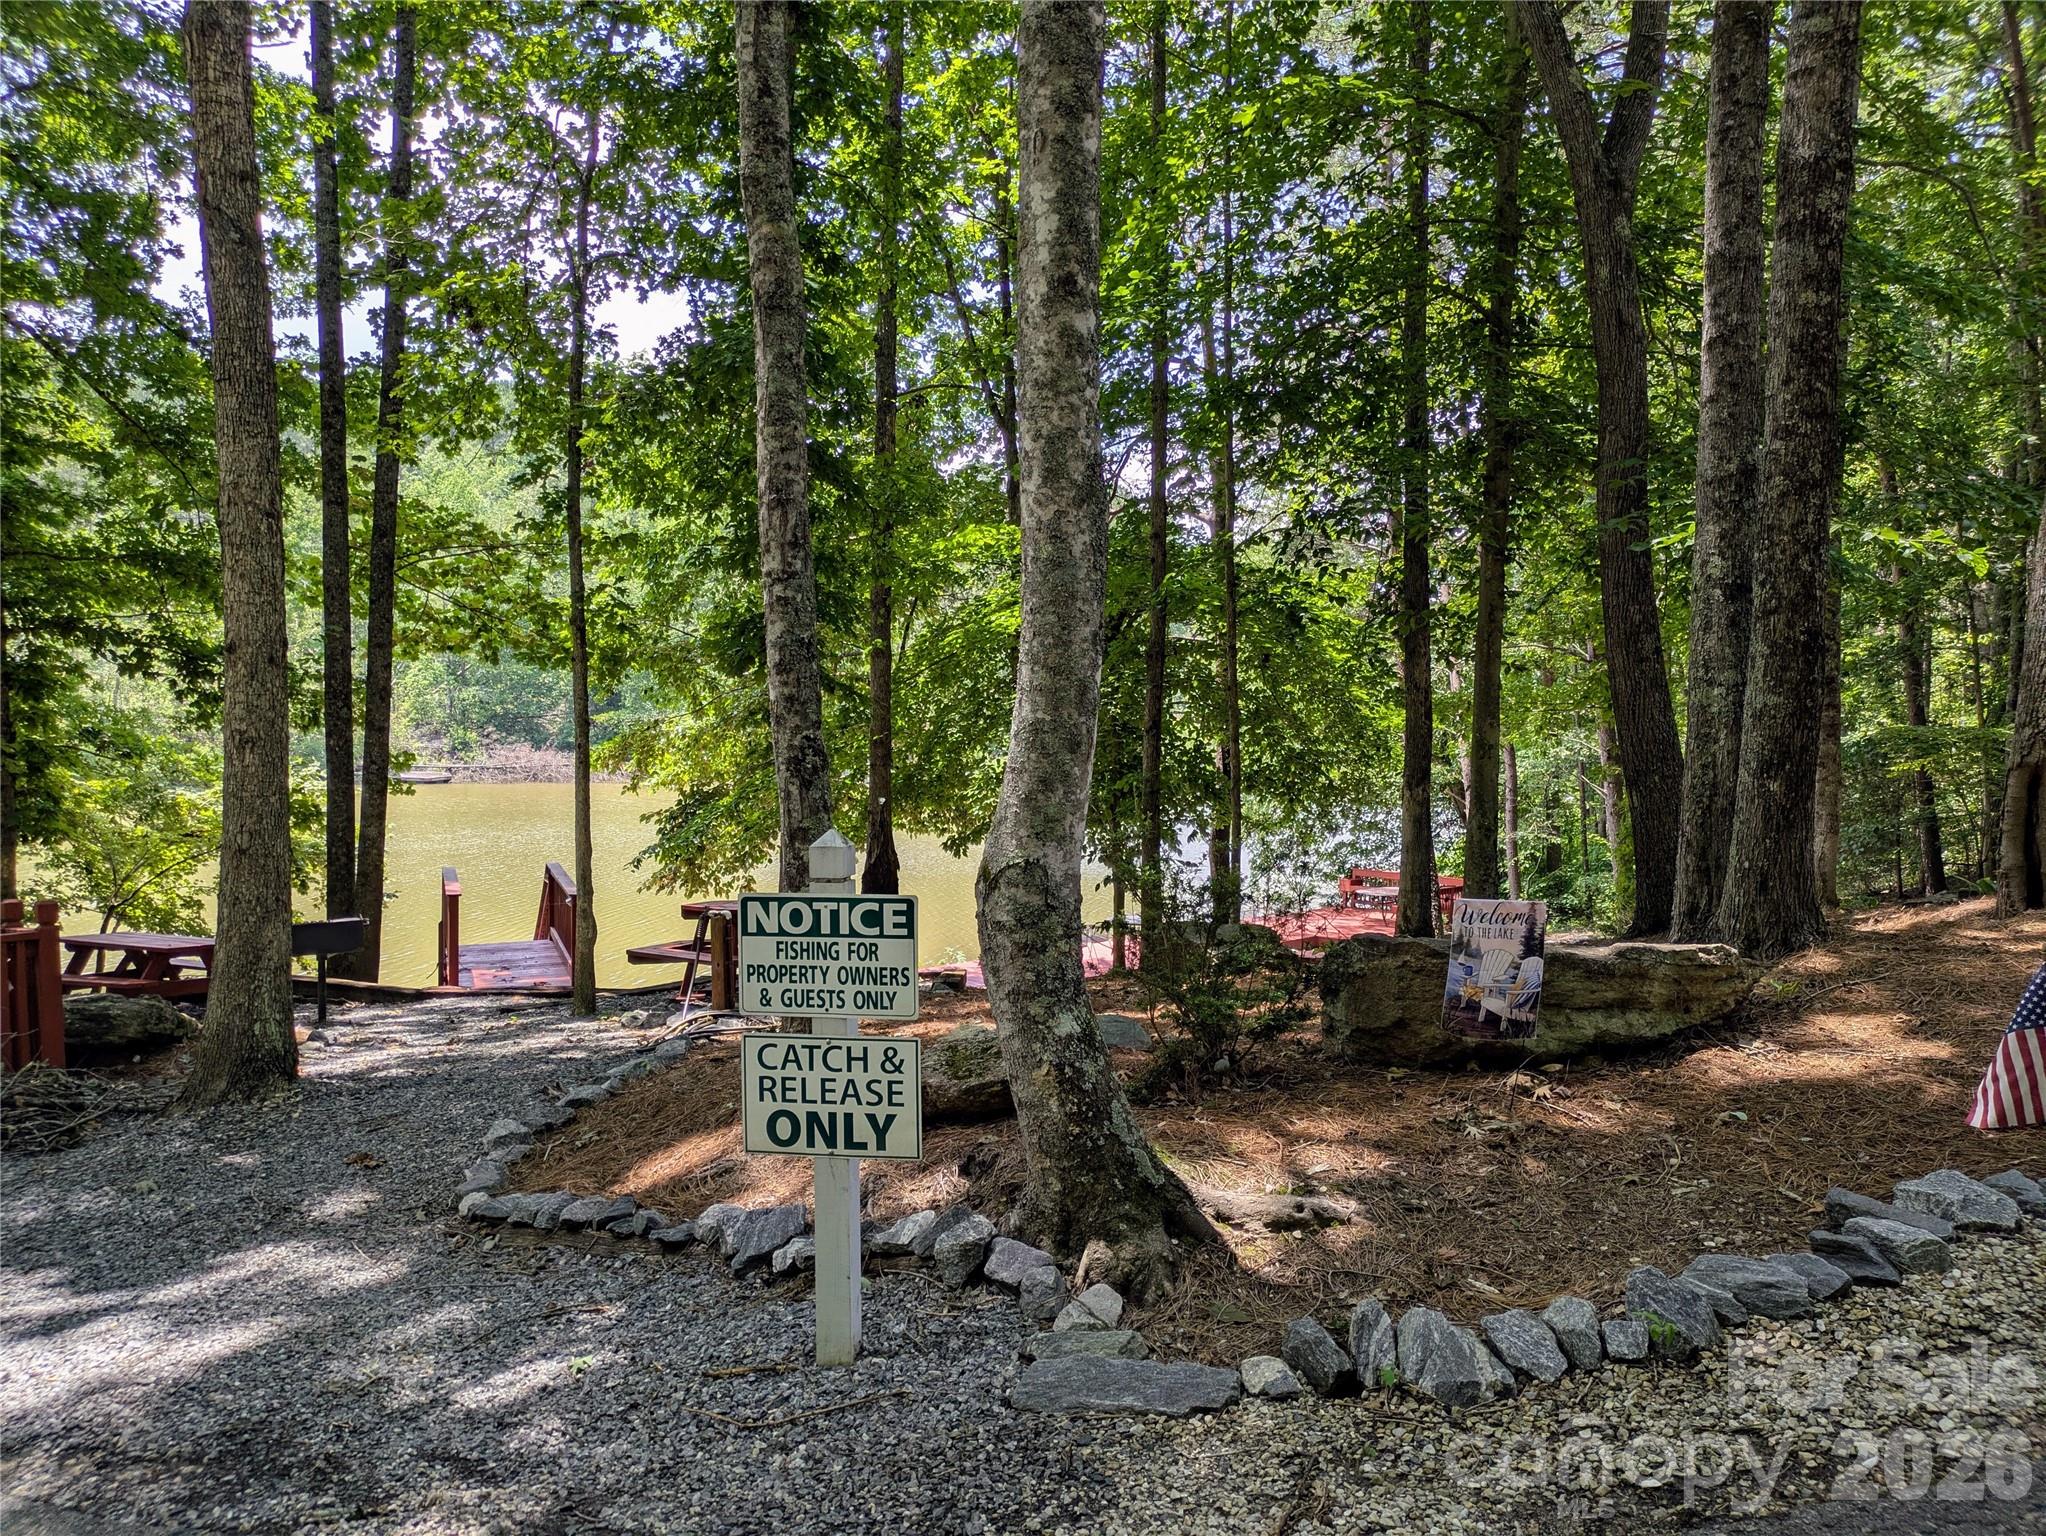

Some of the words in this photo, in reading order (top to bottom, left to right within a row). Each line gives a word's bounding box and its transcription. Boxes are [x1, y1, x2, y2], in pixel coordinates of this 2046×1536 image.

[747, 901, 908, 936] NOTICE
[1455, 902, 1534, 926] Welcome
[1464, 926, 1474, 938] TO
[1477, 926, 1491, 940] THE
[1494, 926, 1514, 940] LAKE
[776, 940, 840, 961] FISHING
[847, 942, 879, 962] FOR
[747, 964, 830, 985] PROPERTY
[837, 966, 910, 987] OWNERS
[759, 988, 772, 1007] &
[780, 988, 846, 1009] GUESTS
[853, 990, 897, 1011] ONLY
[757, 1043, 869, 1073] CATCH
[880, 1046, 905, 1075] &
[759, 1075, 905, 1108] RELEASE
[766, 1109, 897, 1151] ONLY
